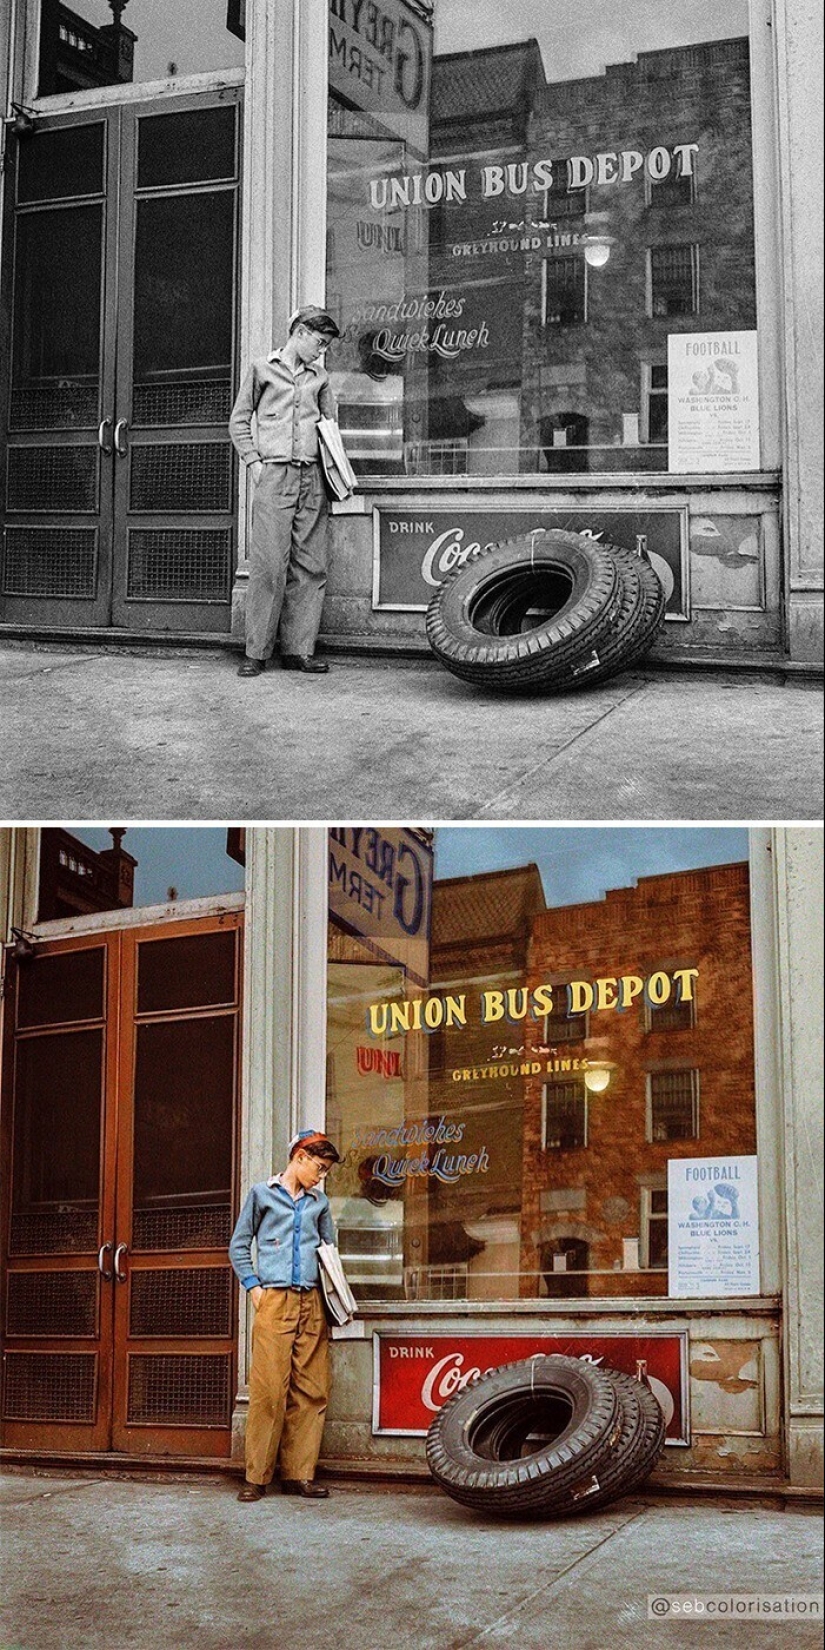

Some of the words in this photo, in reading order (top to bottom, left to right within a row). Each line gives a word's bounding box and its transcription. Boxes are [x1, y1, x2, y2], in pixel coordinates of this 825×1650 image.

[369, 170, 467, 209] UNION
[483, 159, 553, 198] BUS
[568, 143, 699, 190] DEPOT
[452, 237, 541, 257] GREYHOUND
[546, 233, 589, 248] LINES
[431, 321, 490, 358] Lunch
[685, 341, 741, 356] FOOTBALL
[389, 521, 434, 534] DRINK
[369, 995, 467, 1034] UNION
[483, 984, 553, 1023] BUS
[568, 968, 699, 1015] DEPOT
[452, 1062, 541, 1082] GREYHOUND
[546, 1058, 589, 1073] LINES
[431, 1146, 490, 1183] Lunch
[685, 1166, 741, 1181] FOOTBALL
[678, 1221, 731, 1229] WASHINGTON
[389, 1346, 434, 1359] DRINK
